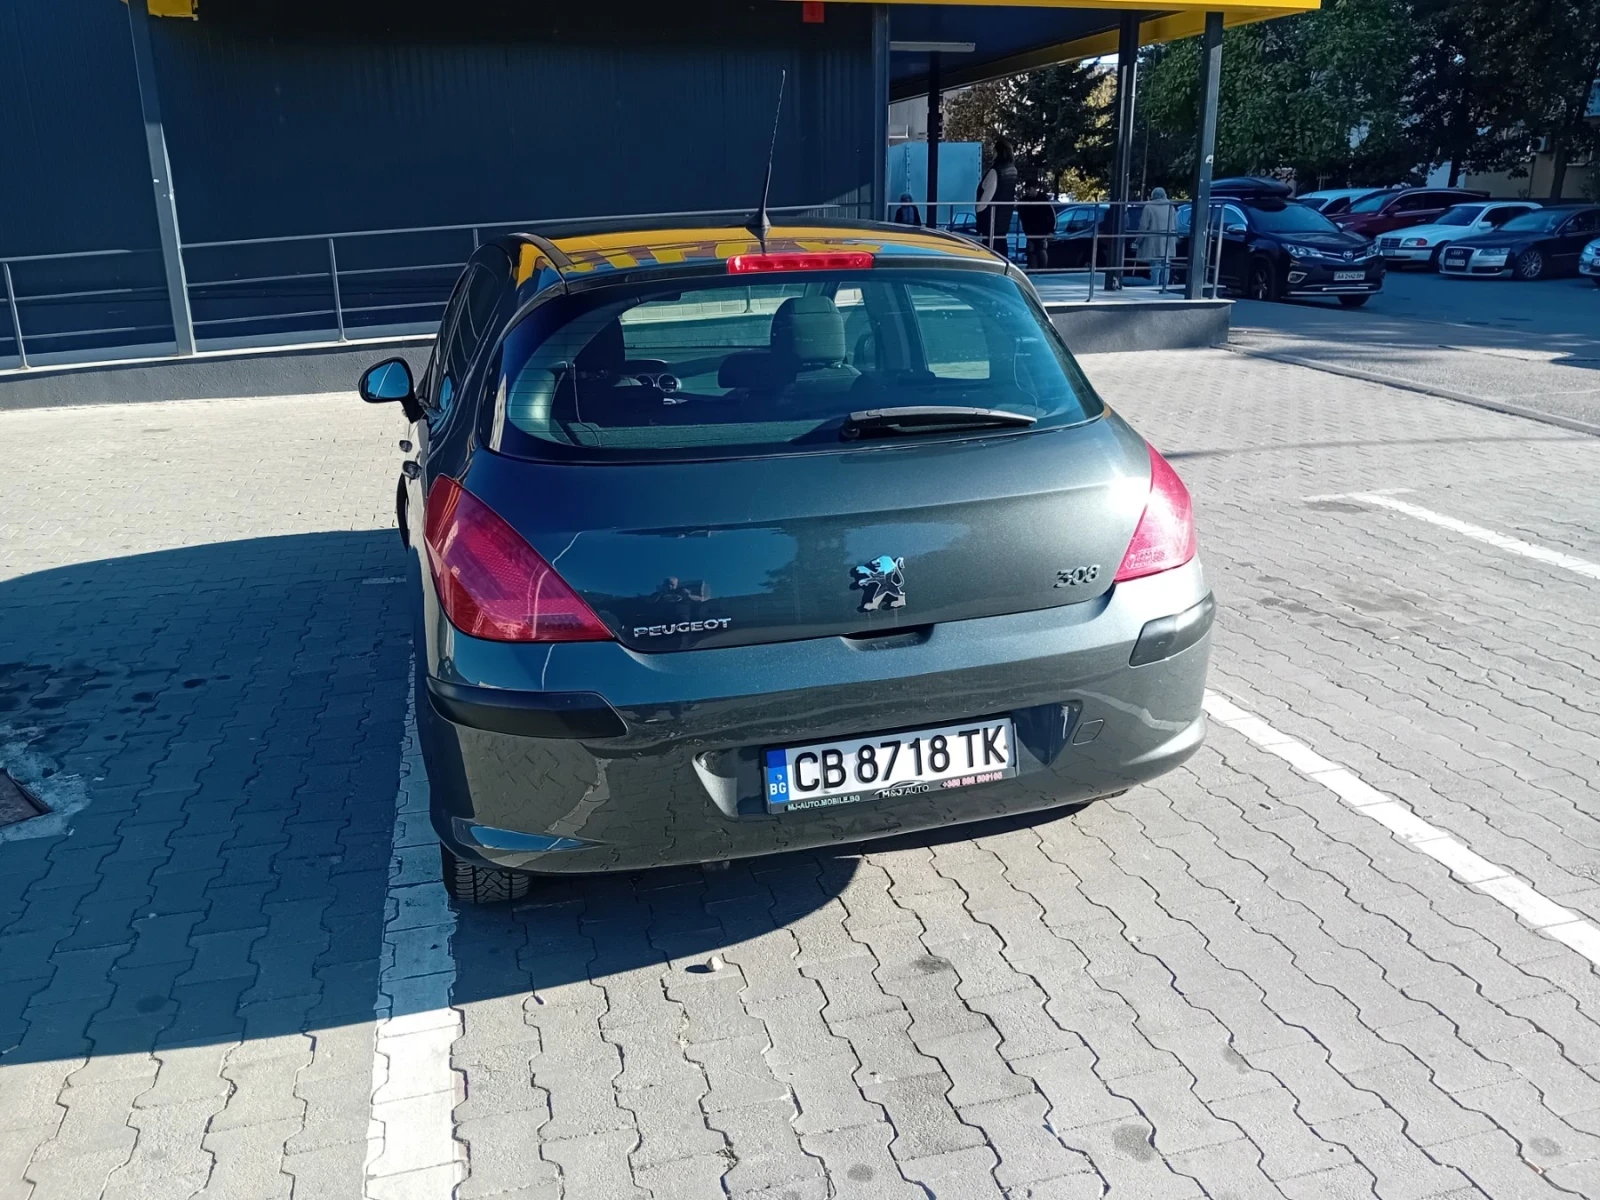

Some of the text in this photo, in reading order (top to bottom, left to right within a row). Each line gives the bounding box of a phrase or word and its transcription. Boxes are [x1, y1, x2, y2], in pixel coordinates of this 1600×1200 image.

[1053, 564, 1100, 588] 308
[633, 617, 732, 638] PEUGEOT
[794, 724, 1006, 792] CB 8718 TK
[769, 781, 787, 796] BG
[882, 784, 930, 799] M&J AUTO
